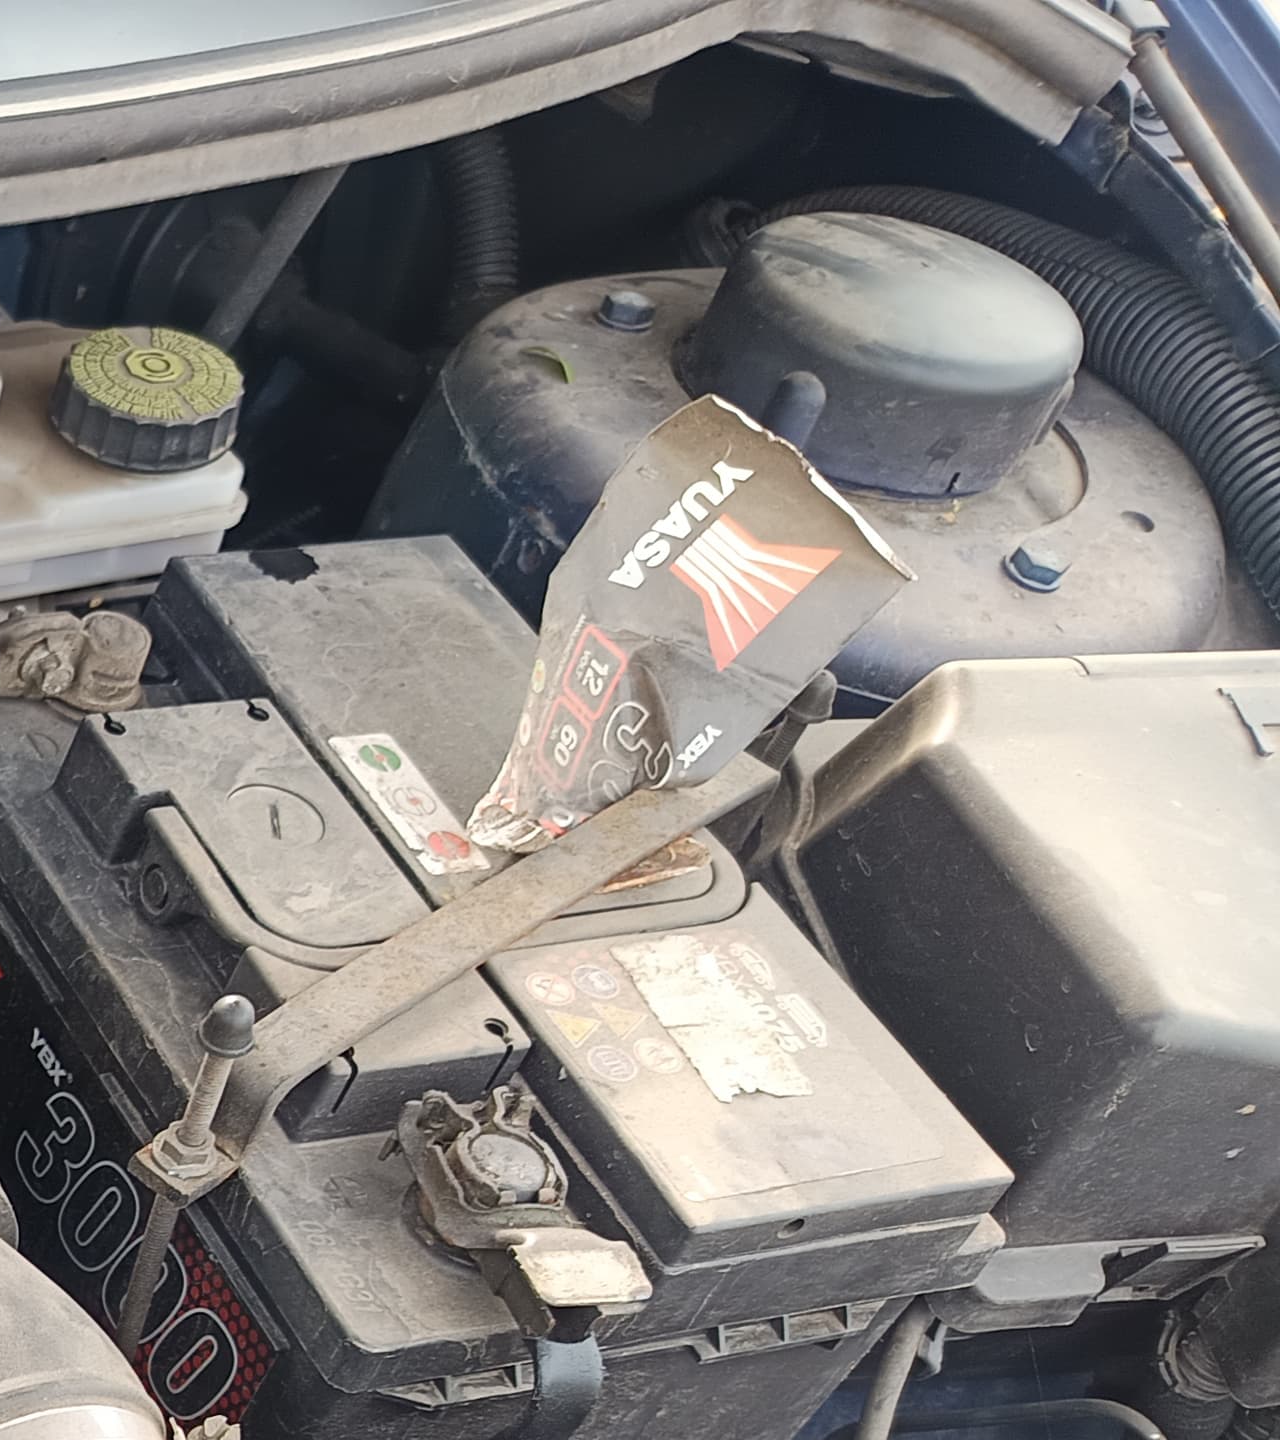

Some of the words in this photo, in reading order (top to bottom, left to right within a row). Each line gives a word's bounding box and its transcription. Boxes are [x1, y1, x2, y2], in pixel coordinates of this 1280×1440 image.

[607, 460, 756, 590] YUASA
[581, 659, 609, 697] 12
[554, 724, 578, 767] 60
[676, 724, 723, 769] YBX
[30, 1026, 67, 1087] YBX
[15, 1091, 238, 1421] 3000
